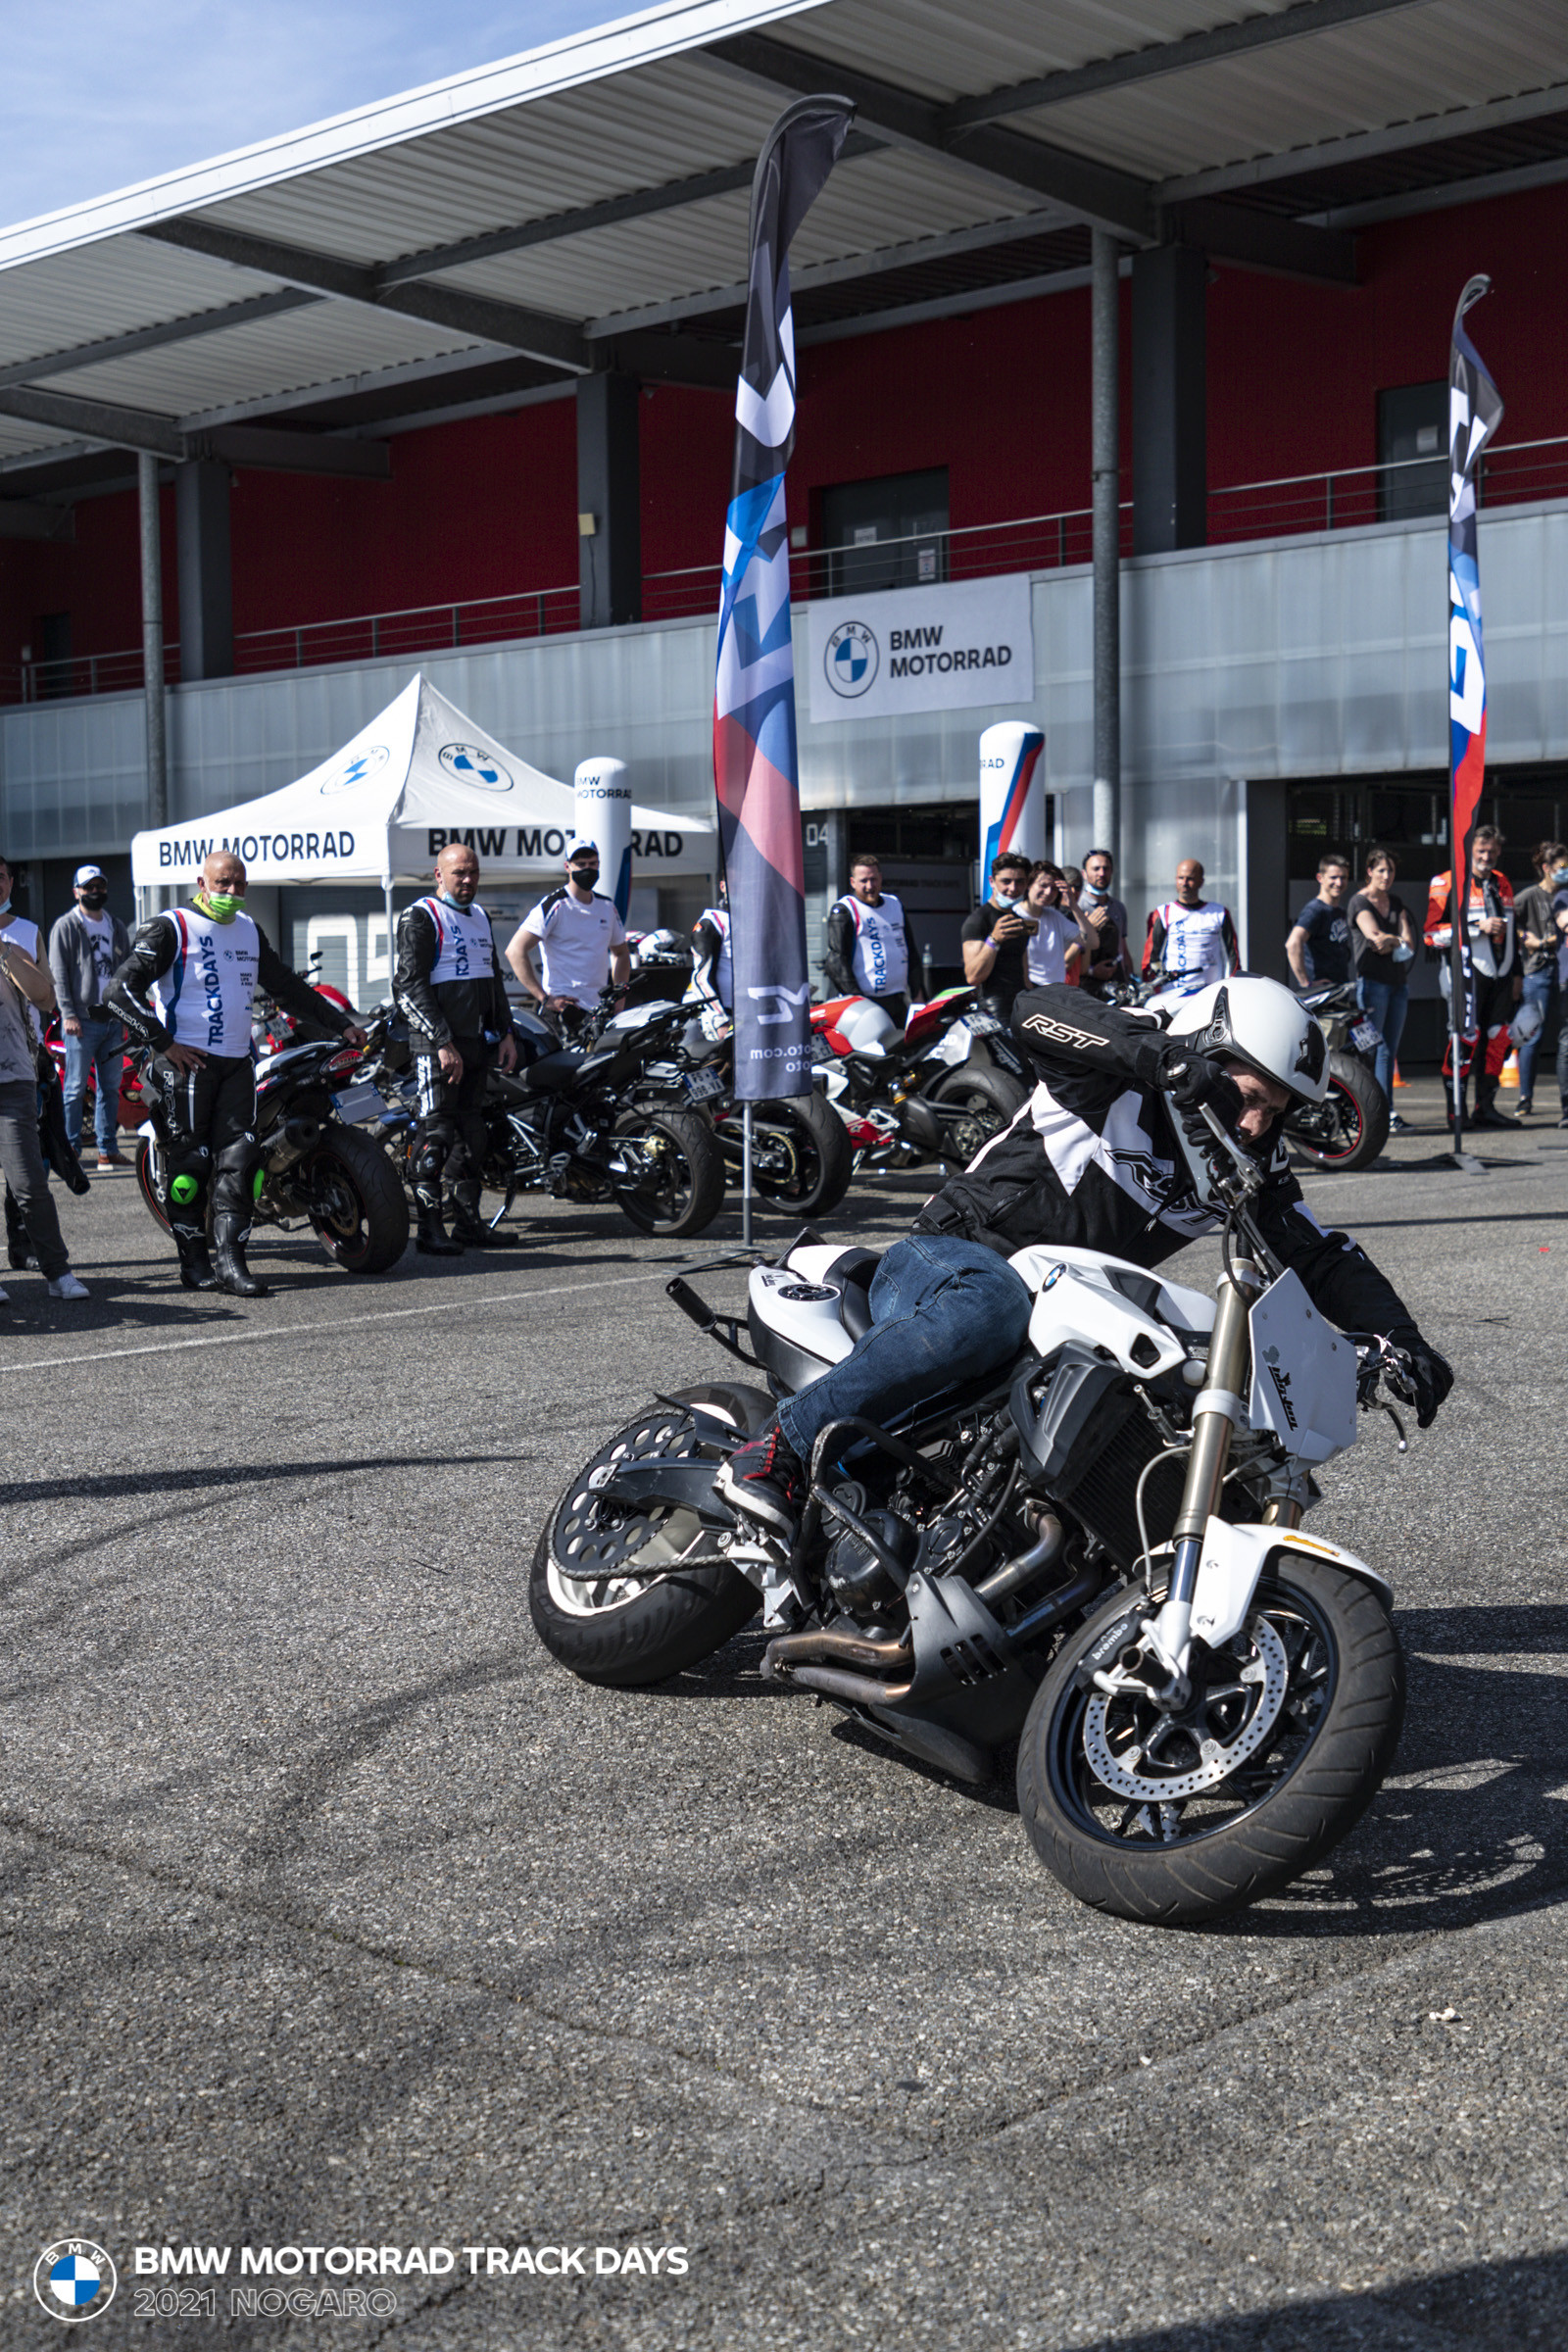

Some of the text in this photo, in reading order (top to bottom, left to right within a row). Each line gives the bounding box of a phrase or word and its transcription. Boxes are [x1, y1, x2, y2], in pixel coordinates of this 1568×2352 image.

[890, 625, 944, 651] BMW
[890, 645, 1012, 678] MOTORRAD
[159, 831, 355, 866] BMW MOTORRAD
[428, 828, 683, 857] BMW MORAD
[866, 916, 886, 994] TRACKDAYS
[1175, 919, 1188, 988] TRCKDAYS
[199, 935, 223, 1047] TRACKDAYS
[1021, 1013, 1110, 1050] RST
[1091, 1623, 1129, 1661] brembo
